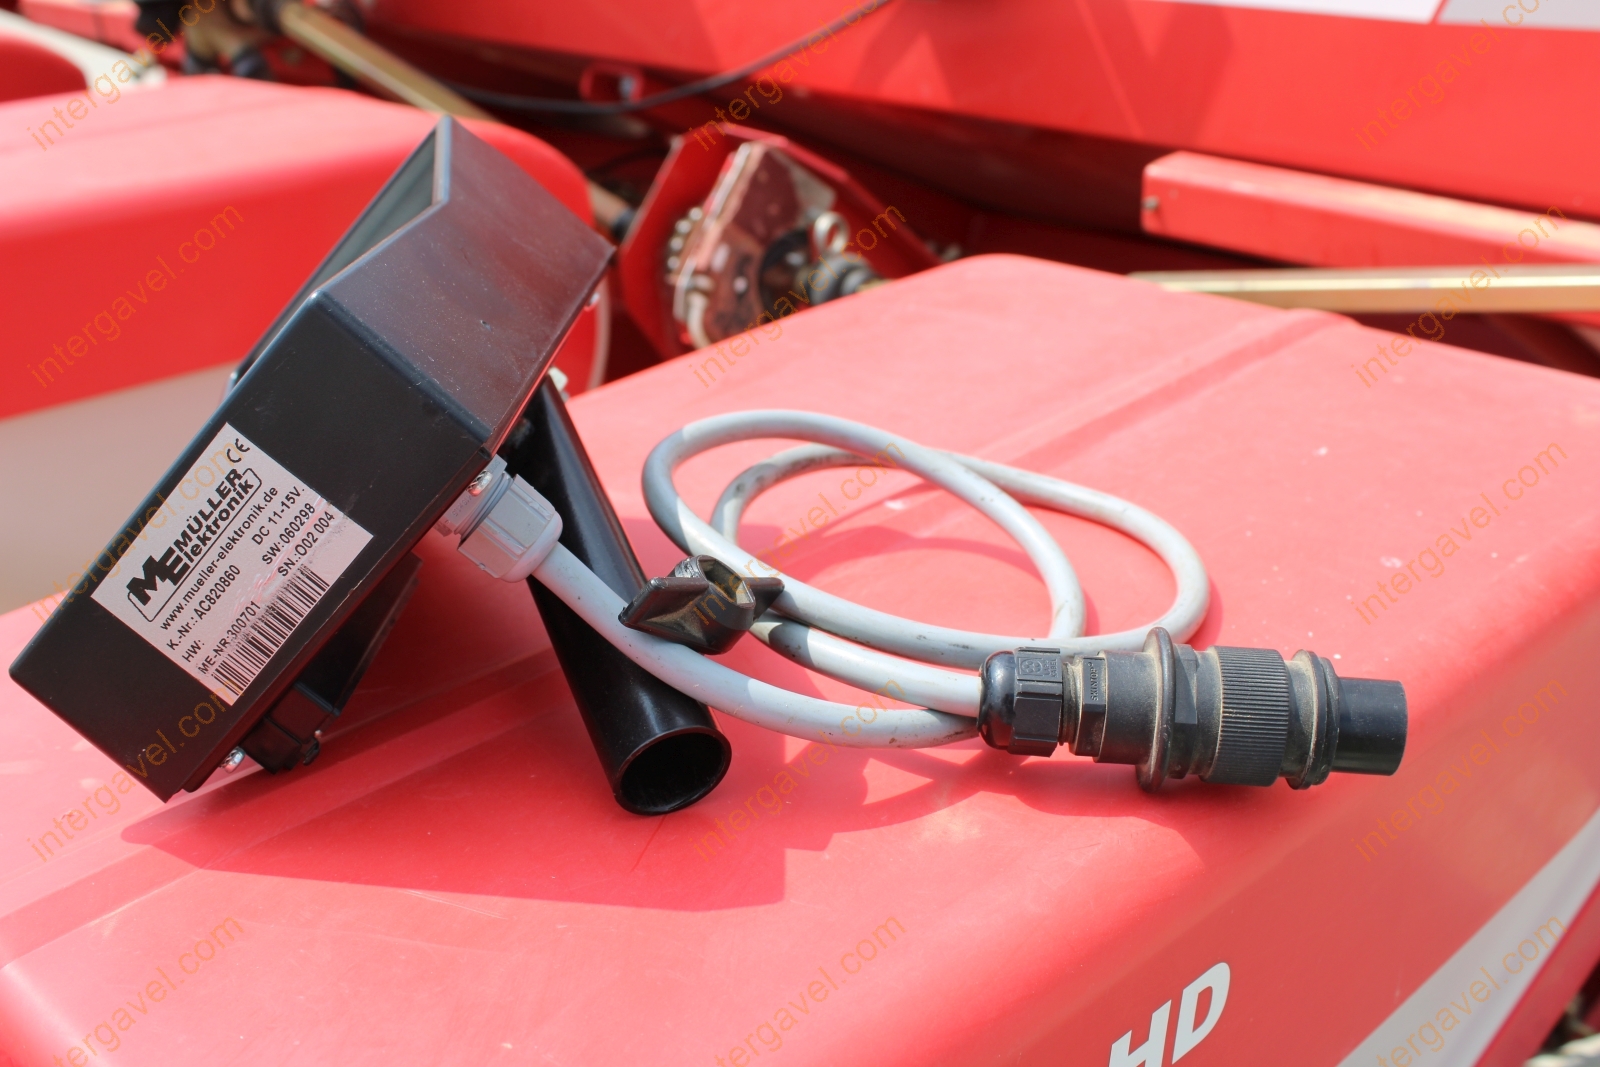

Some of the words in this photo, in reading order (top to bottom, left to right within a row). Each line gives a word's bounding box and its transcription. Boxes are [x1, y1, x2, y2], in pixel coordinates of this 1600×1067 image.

[173, 468, 243, 548] MÜLLER
[251, 525, 270, 545] DC
[160, 486, 278, 631] www.mueller-elektronik.de
[182, 639, 205, 663] HW:
[1108, 962, 1231, 1067] HD
